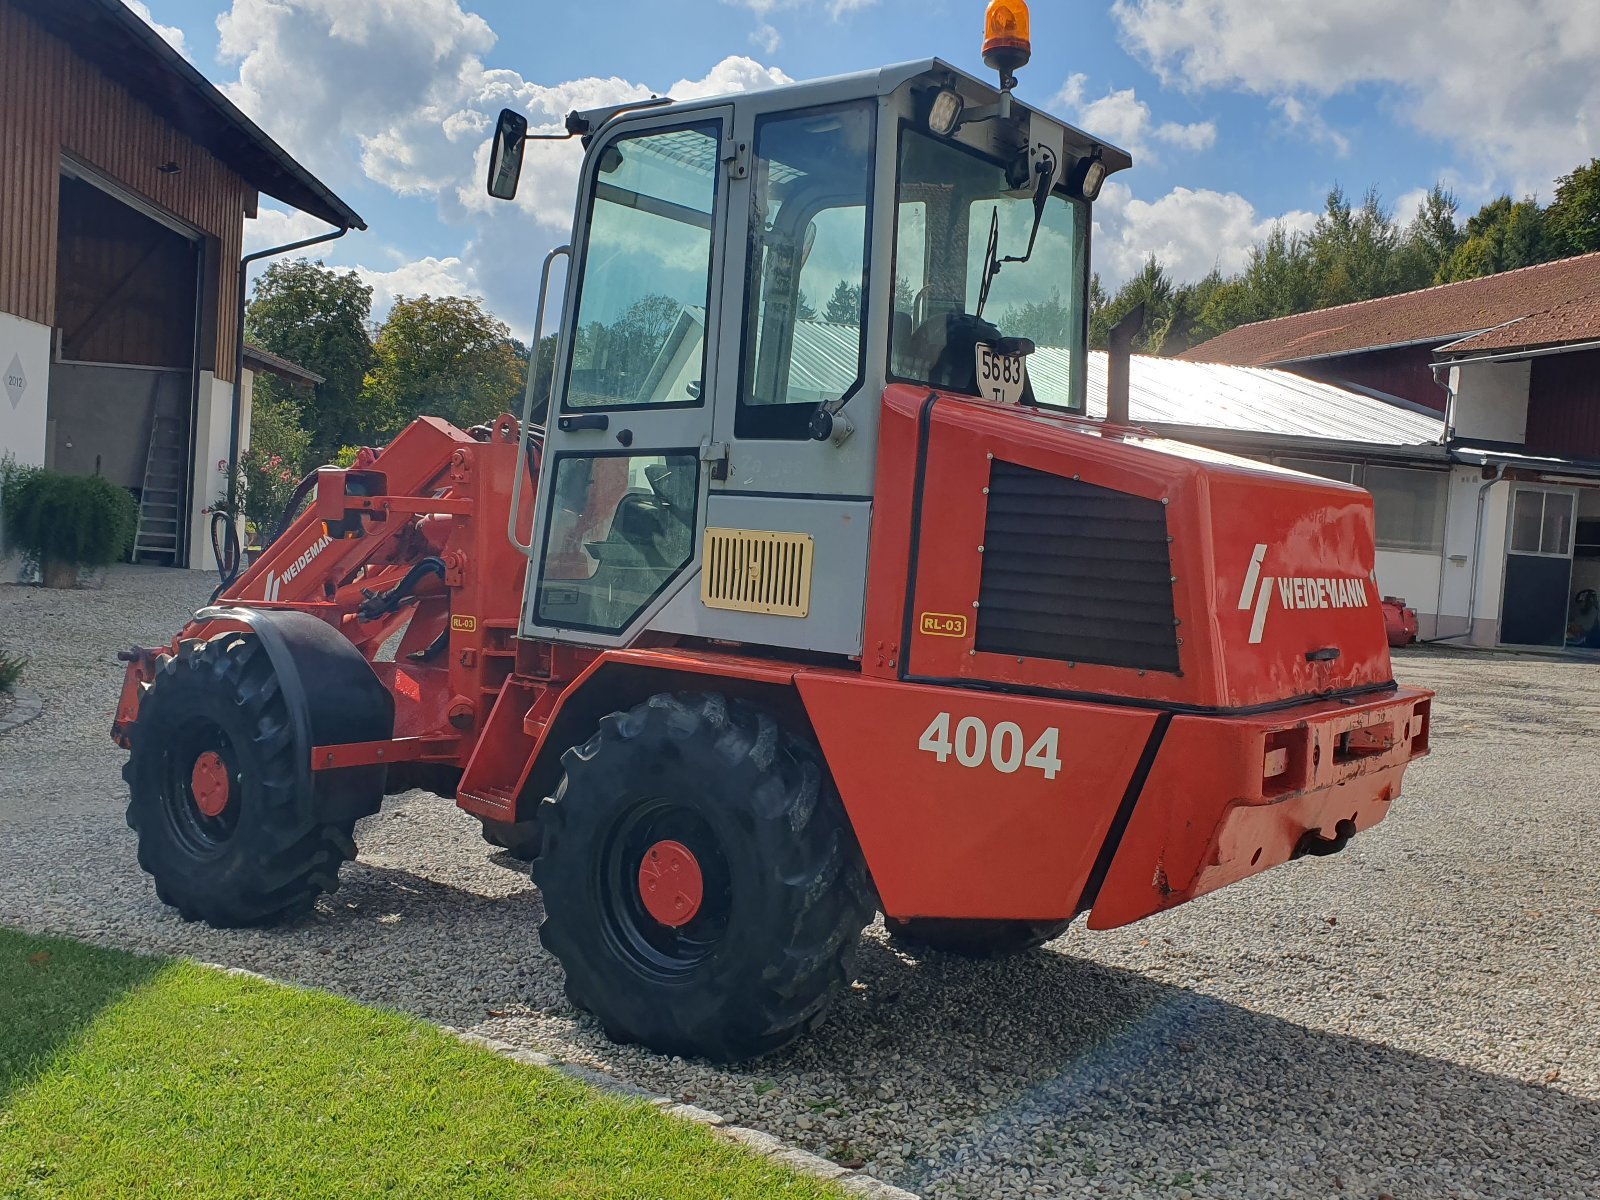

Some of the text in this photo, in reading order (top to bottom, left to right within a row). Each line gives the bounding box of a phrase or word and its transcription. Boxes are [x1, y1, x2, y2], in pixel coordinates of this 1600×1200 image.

[982, 350, 1021, 385] 5683
[8, 375, 23, 388] 2012
[1278, 577, 1368, 610] WEIDEMANN
[453, 618, 474, 628] RL-03
[924, 617, 962, 632] RL-03
[918, 711, 1062, 780] 4004
